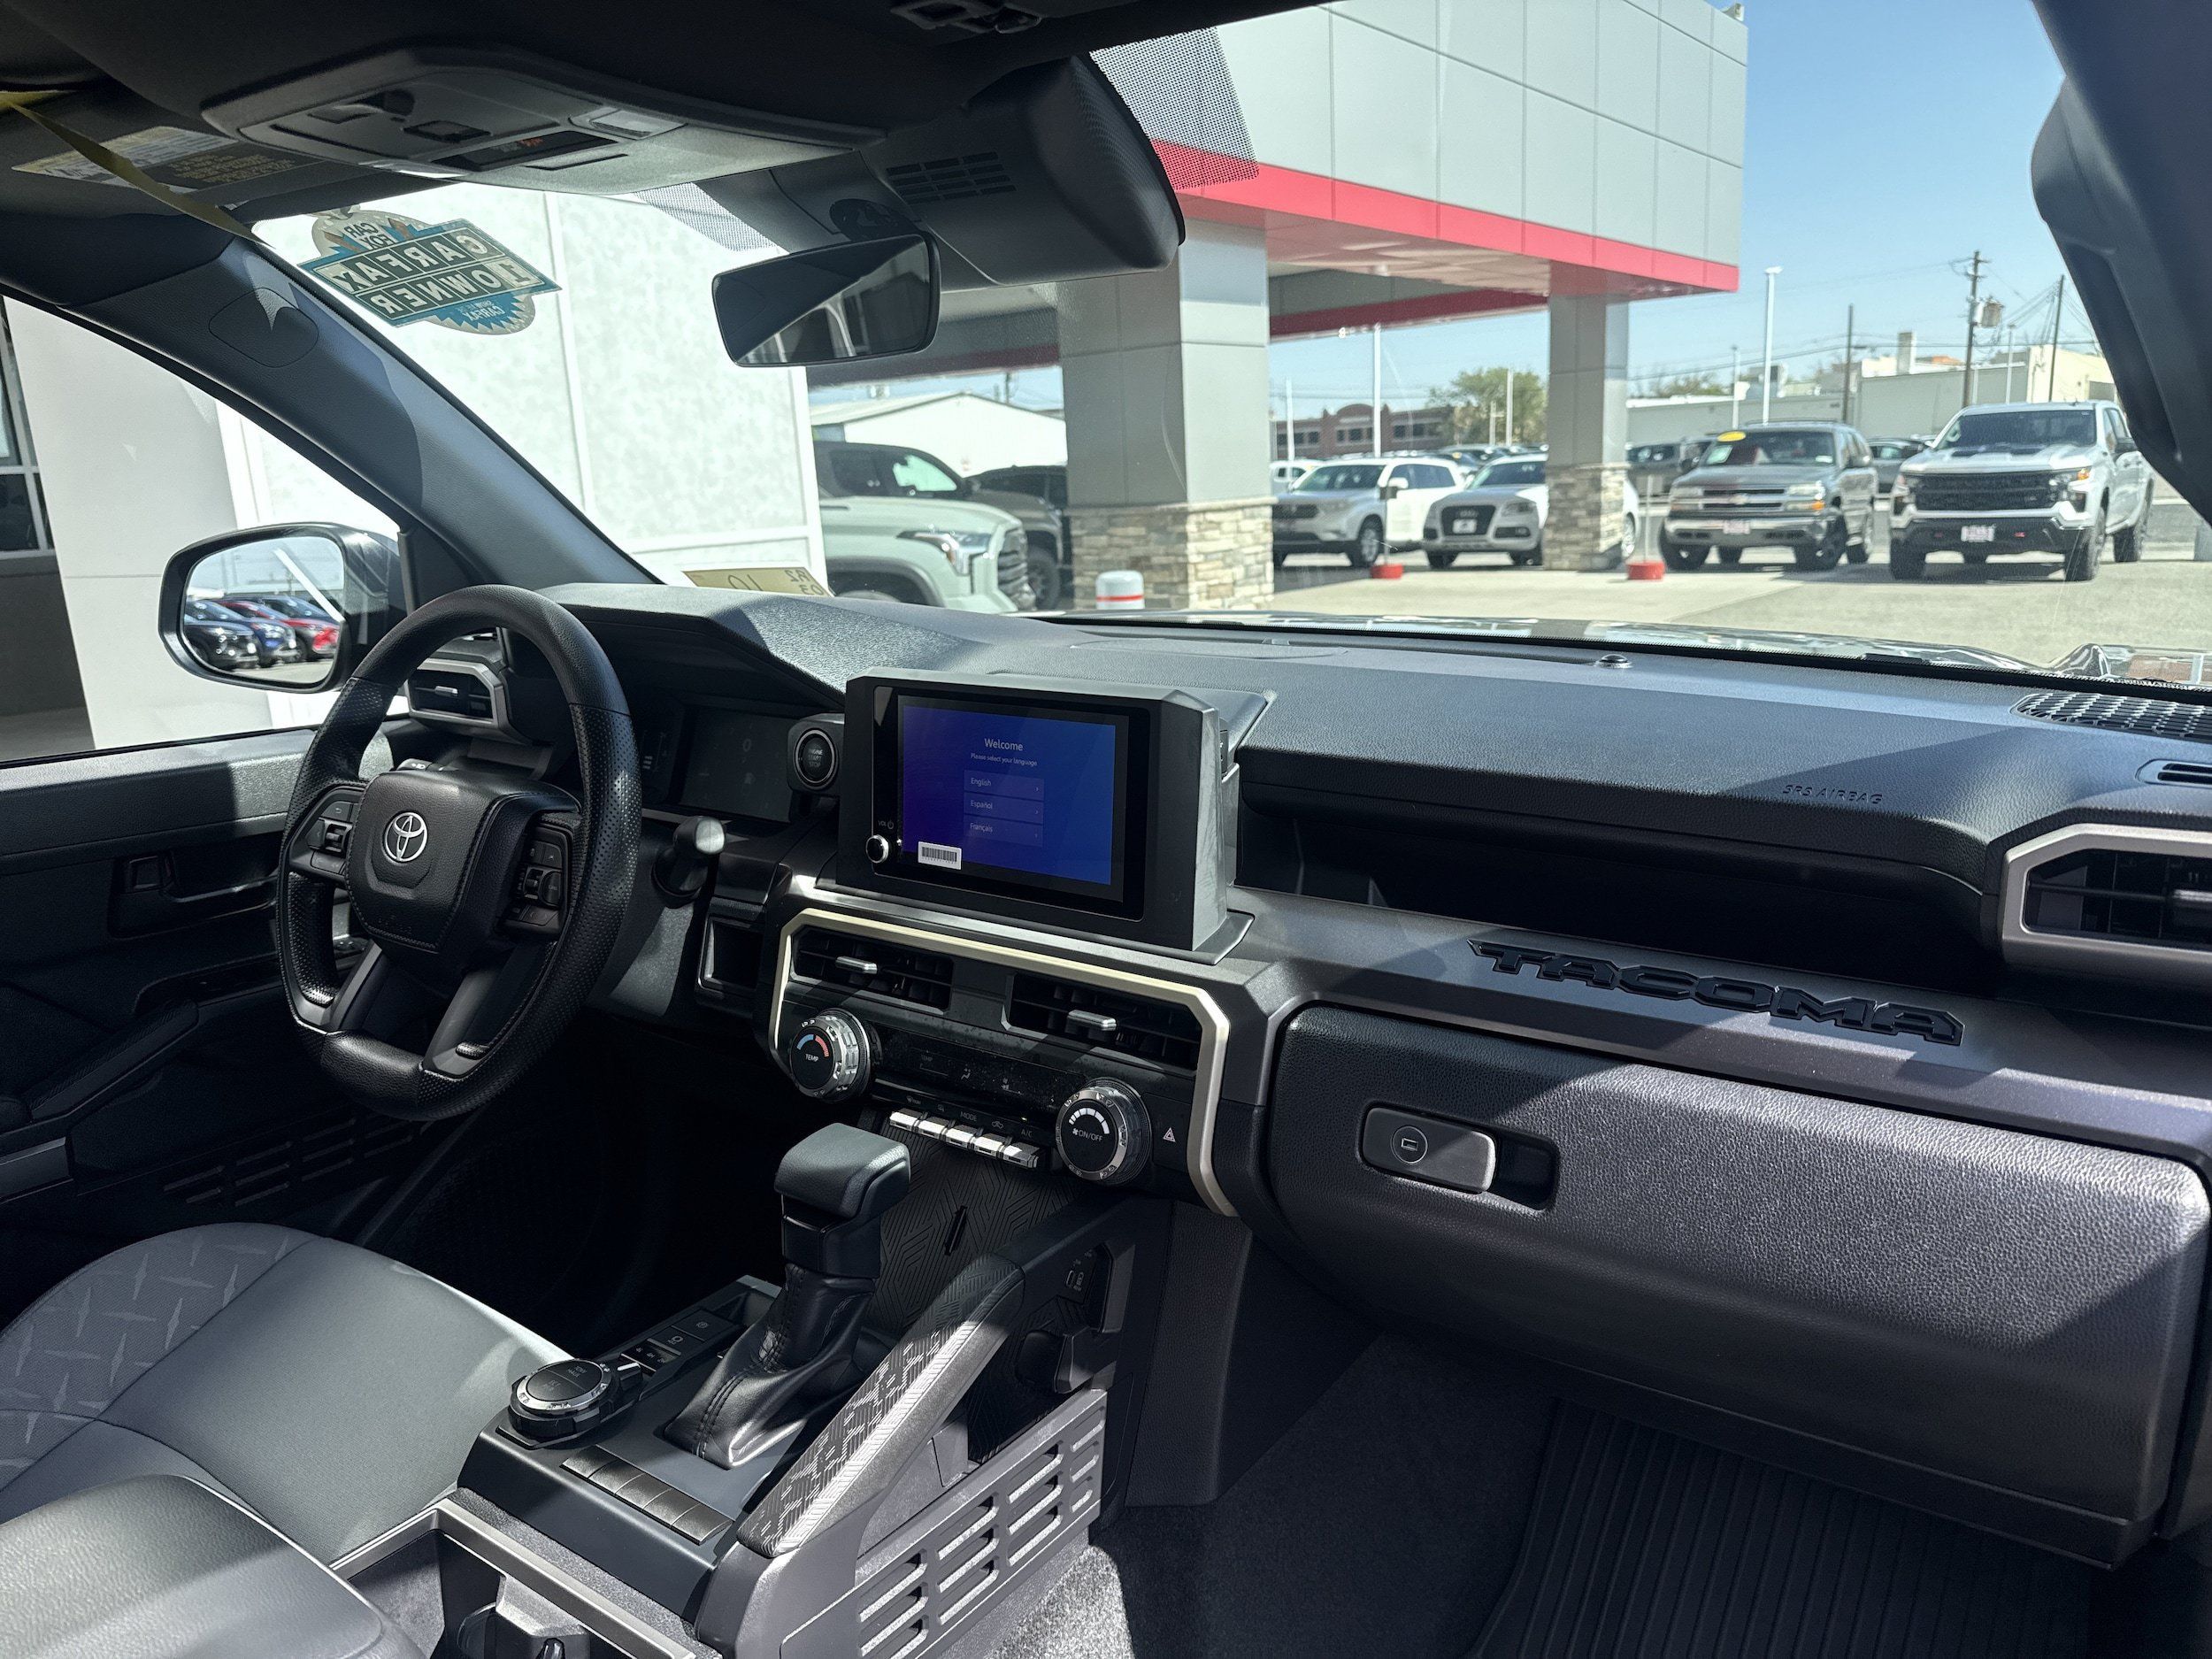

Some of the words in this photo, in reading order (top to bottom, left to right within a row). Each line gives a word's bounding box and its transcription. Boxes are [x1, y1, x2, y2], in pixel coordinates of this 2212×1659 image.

[984, 738, 1024, 751] Welcome
[1013, 757, 1038, 767] language
[971, 778, 992, 787] English
[1783, 785, 1813, 796] SRS
[1816, 788, 1883, 804] AIRBAG
[970, 800, 993, 809] Español
[970, 823, 994, 833] Français
[1467, 939, 1965, 1046] TACOMA
[805, 1053, 819, 1062] TEMP
[960, 1111, 977, 1122] MODE
[1021, 1128, 1033, 1138] A/C
[1078, 1129, 1103, 1142] ON/OFF
